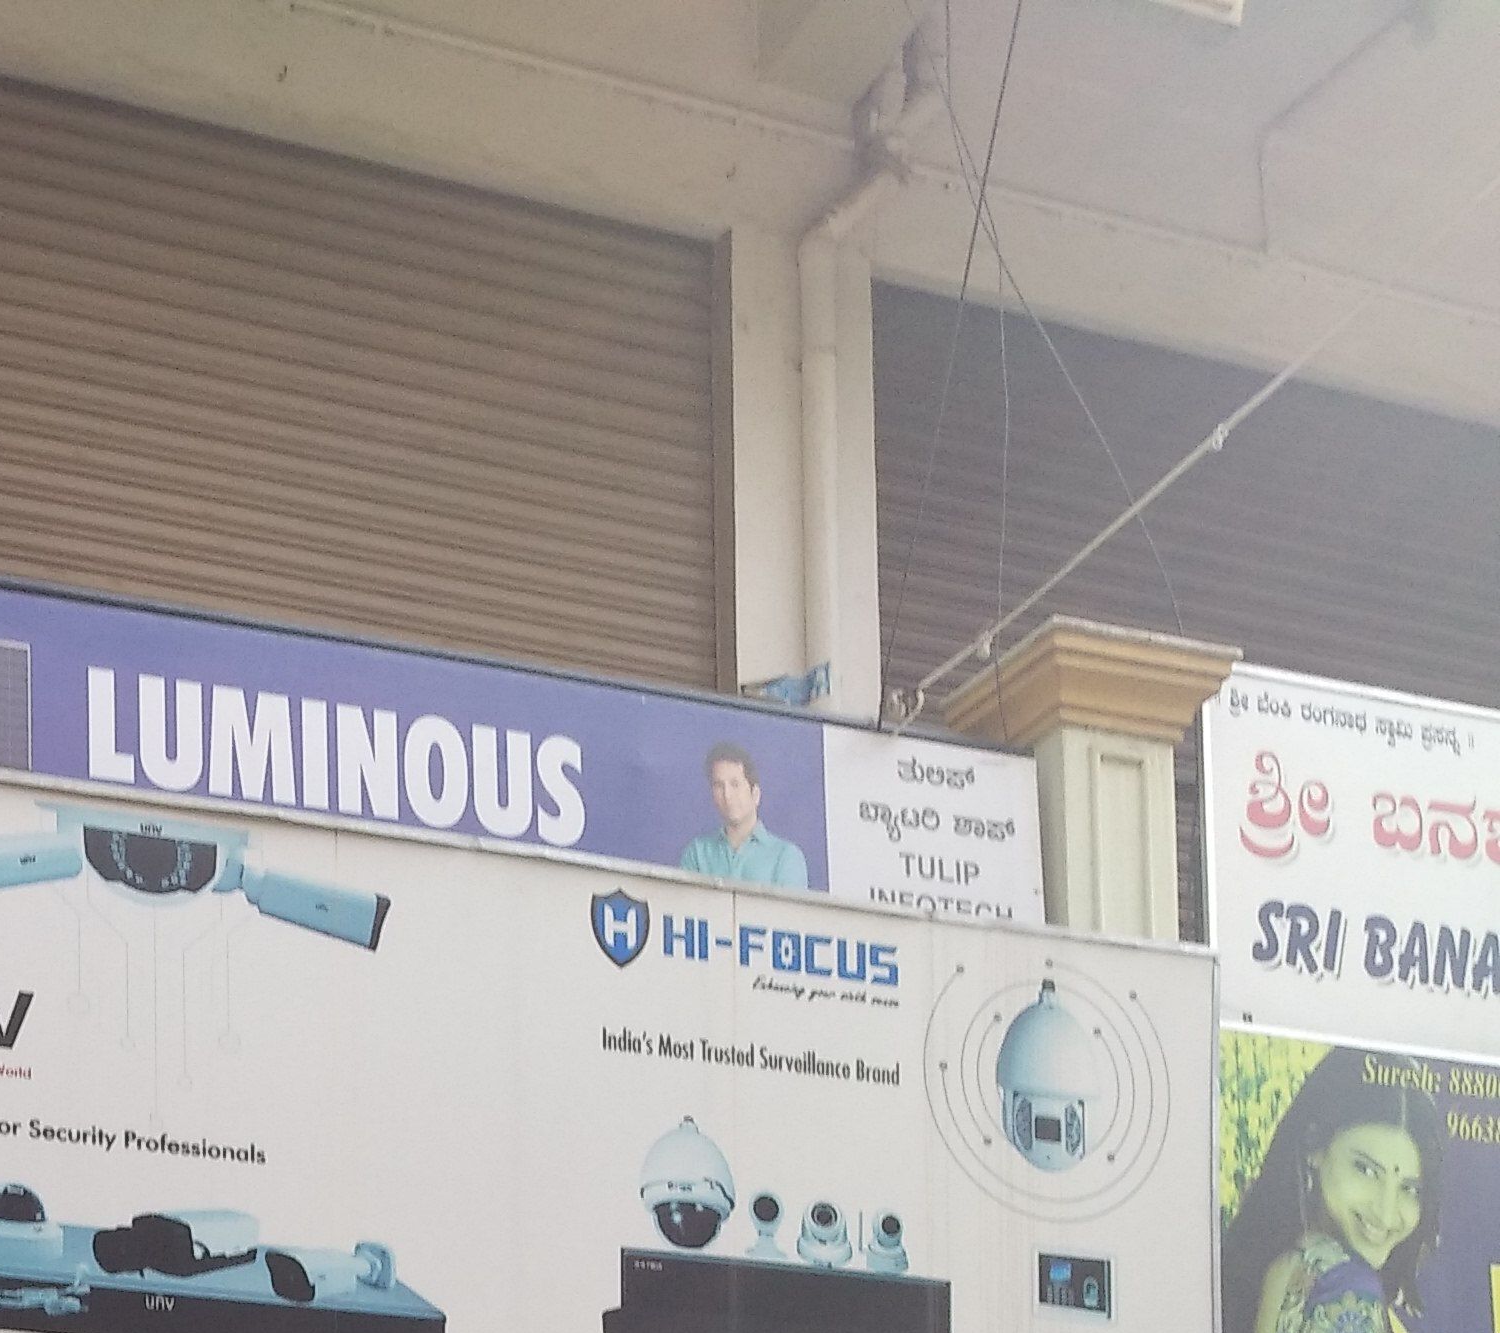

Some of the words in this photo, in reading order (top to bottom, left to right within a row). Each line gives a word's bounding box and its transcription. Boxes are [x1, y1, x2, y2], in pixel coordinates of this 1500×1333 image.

[87, 665, 586, 848] LUMINOUS
[1239, 750, 1332, 860] ಶ್ರೀ
[899, 851, 980, 886] TULIP
[663, 914, 899, 986] HI-FOCUS
[1252, 899, 1345, 975] SRI
[601, 1026, 653, 1055] India's
[659, 1032, 694, 1061] Most
[699, 1037, 755, 1068] Trusted
[759, 1048, 851, 1080] Surveillance
[856, 1058, 900, 1086] Brand
[1362, 1053, 1441, 1095] Suresh:
[1449, 1067, 1500, 1106] 8880
[28, 1120, 116, 1152] Security
[124, 1131, 267, 1165] Professionals
